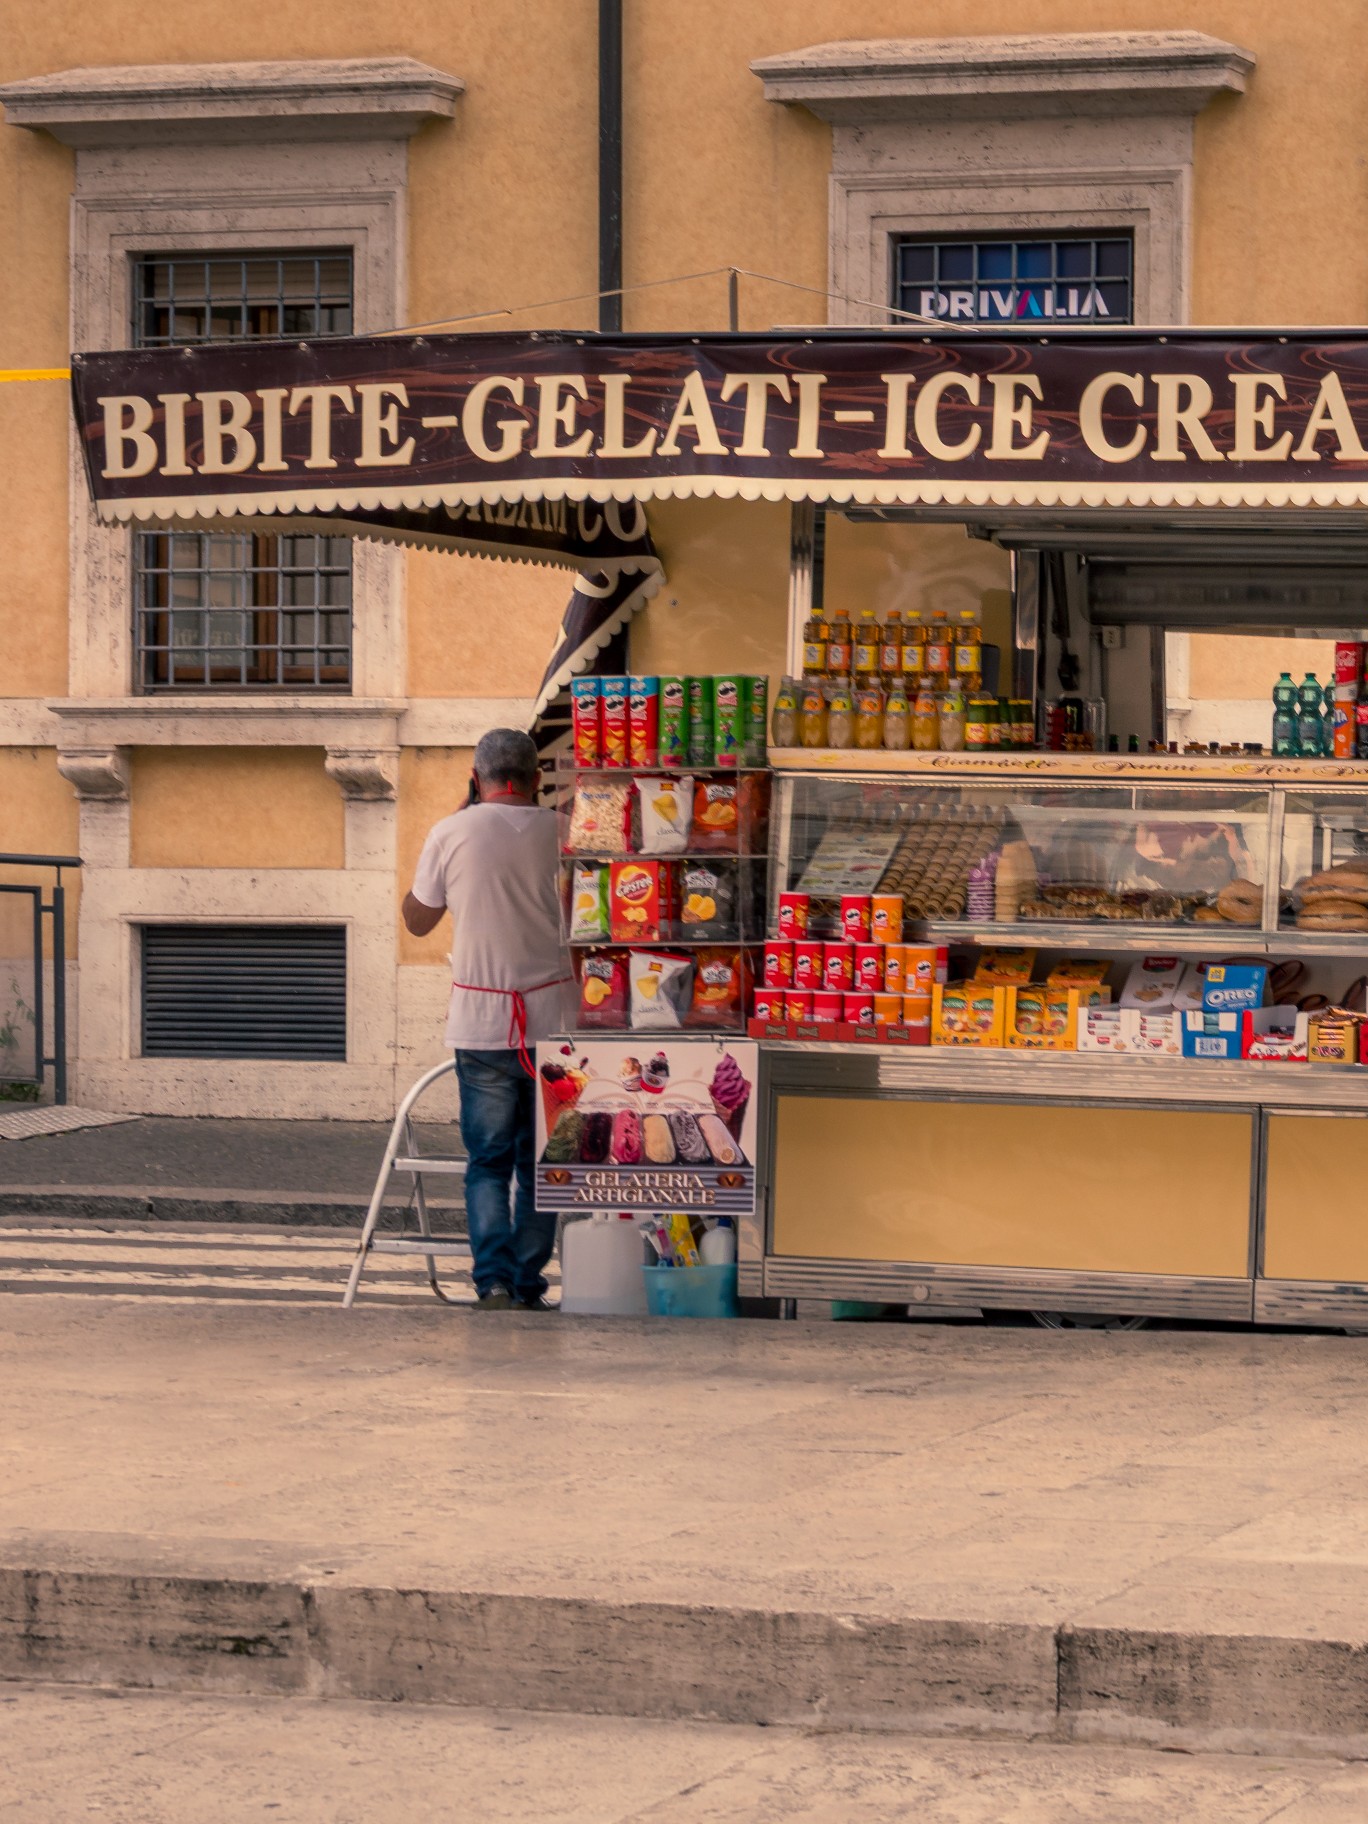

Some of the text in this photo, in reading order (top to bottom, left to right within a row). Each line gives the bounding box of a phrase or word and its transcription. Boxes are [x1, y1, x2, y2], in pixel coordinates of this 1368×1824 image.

[1206, 988, 1257, 1007] OREO
[585, 1171, 706, 1189] GELATERIA
[573, 1187, 717, 1206] ARTIGIANALE
